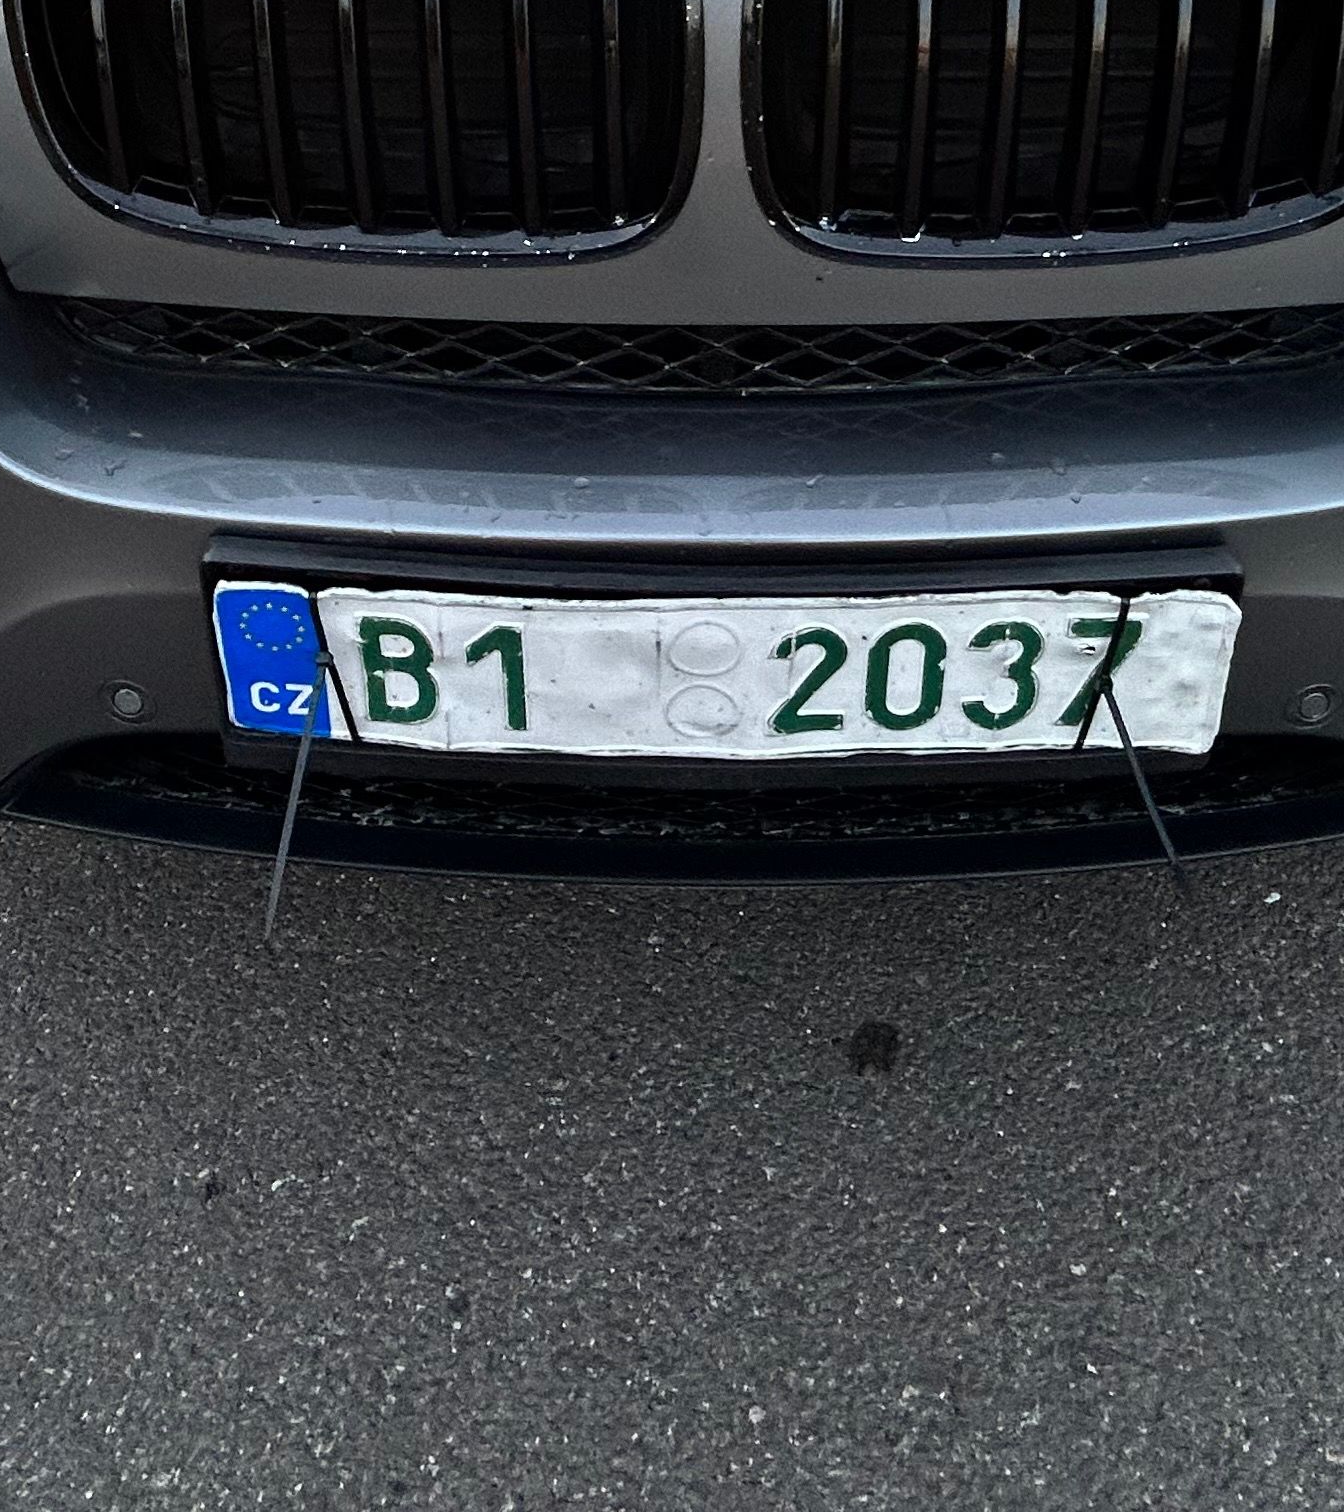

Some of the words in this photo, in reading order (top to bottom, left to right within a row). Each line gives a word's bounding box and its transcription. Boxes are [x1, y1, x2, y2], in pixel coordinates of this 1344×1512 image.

[249, 681, 316, 717] CZ
[357, 612, 528, 732] B1
[768, 614, 1146, 735] 2037
